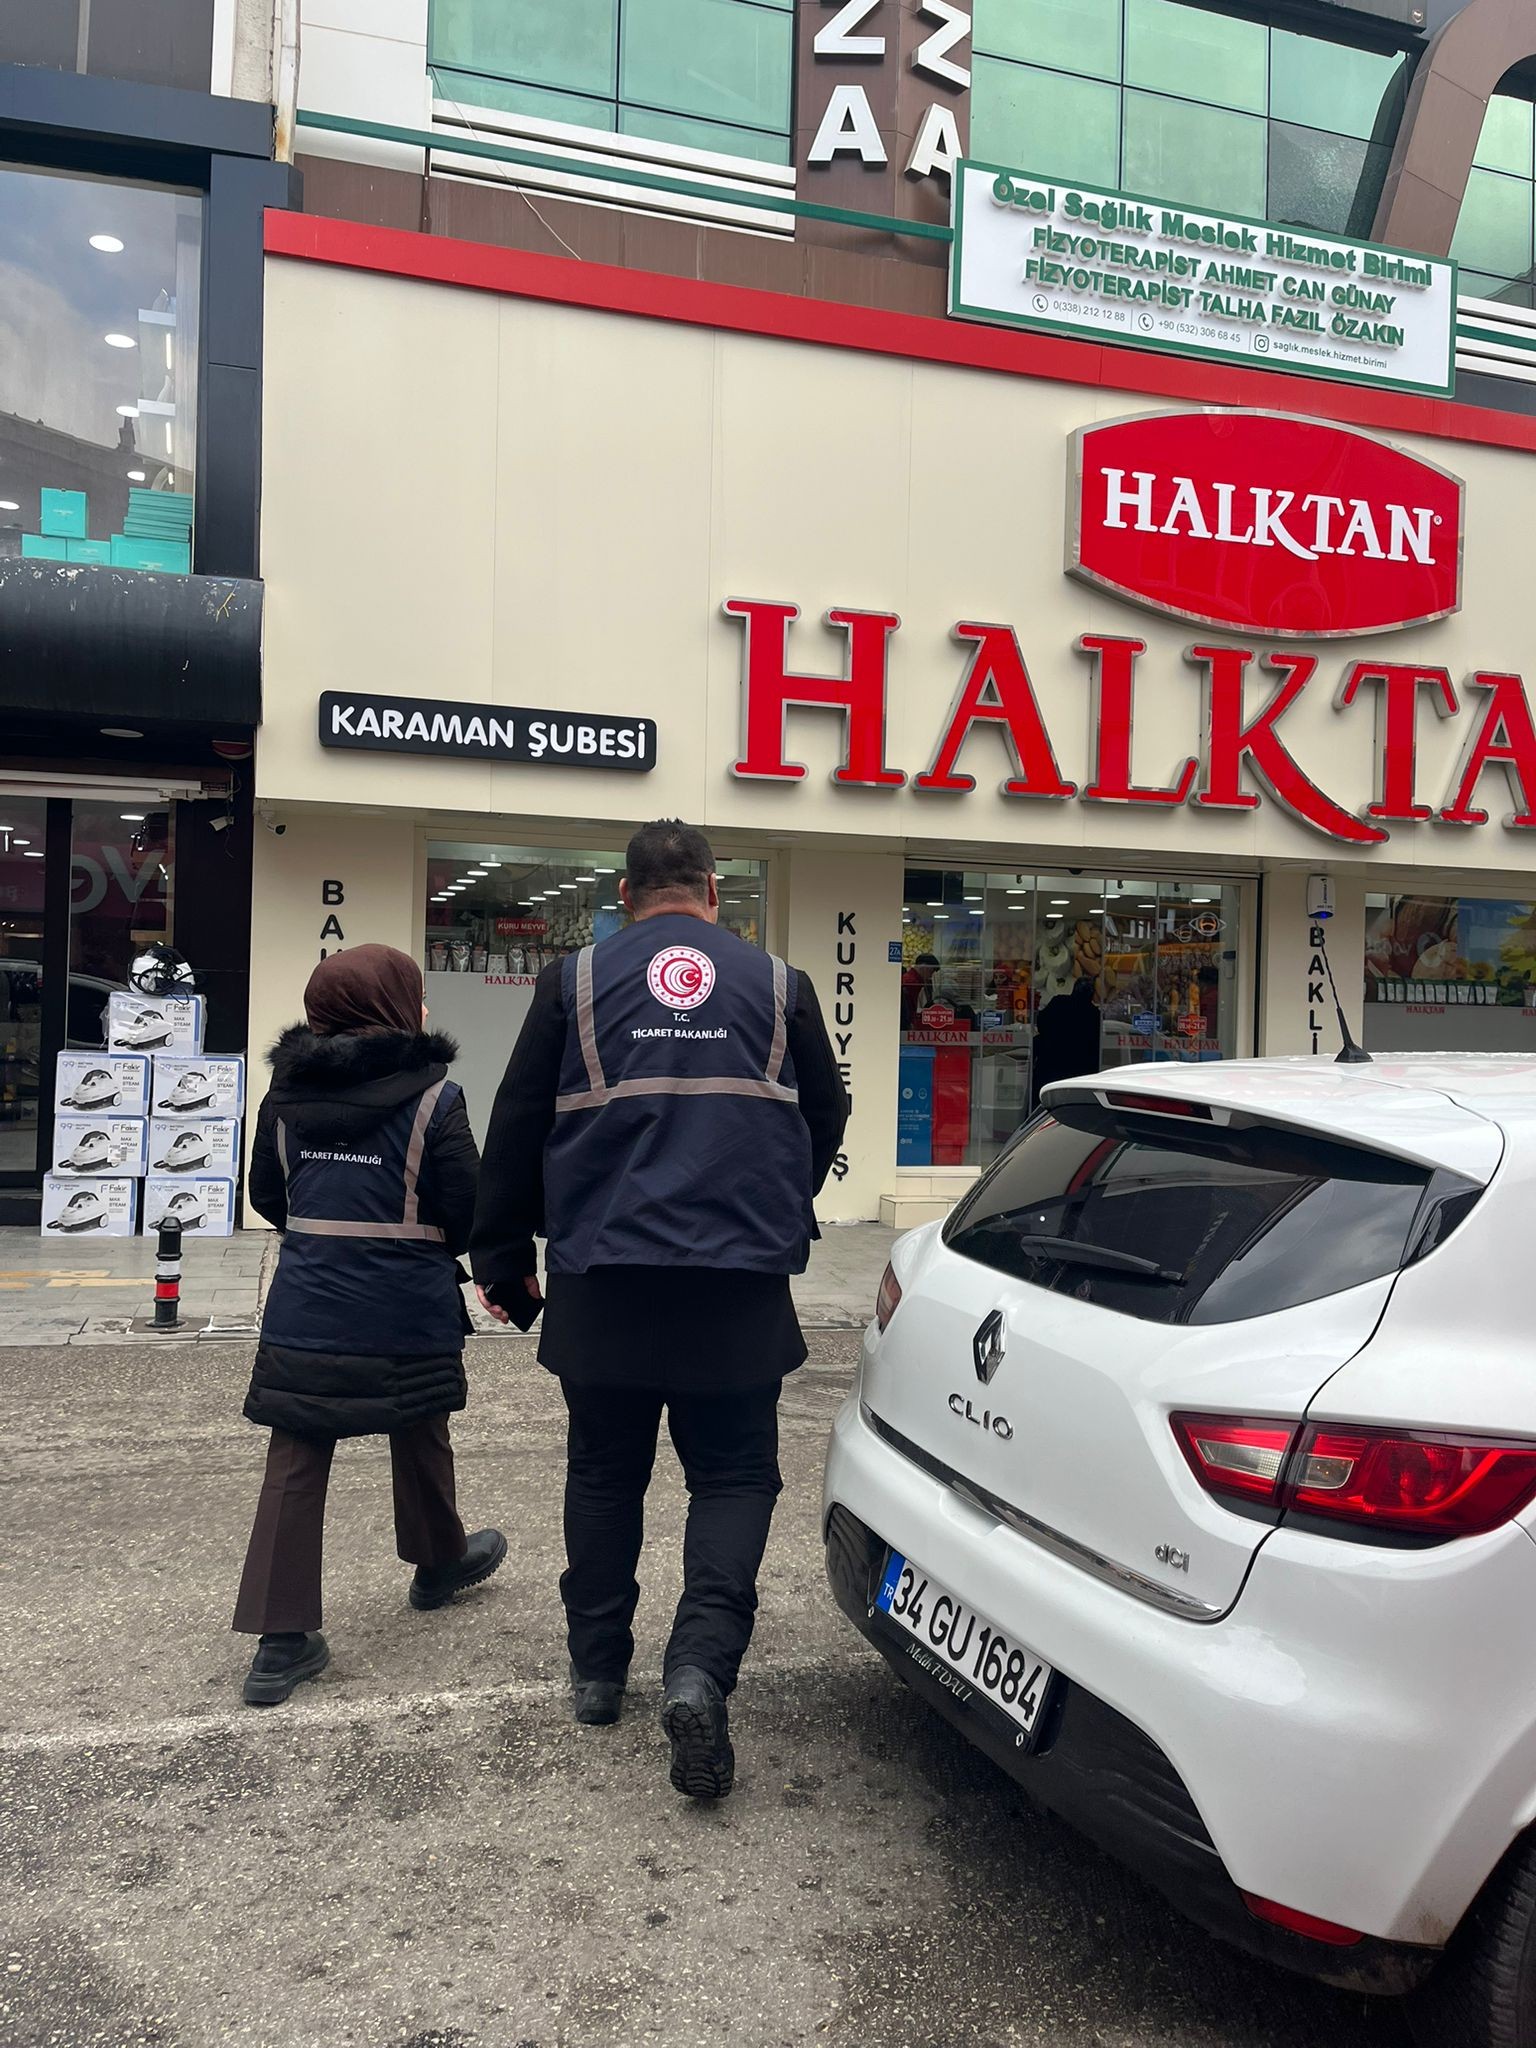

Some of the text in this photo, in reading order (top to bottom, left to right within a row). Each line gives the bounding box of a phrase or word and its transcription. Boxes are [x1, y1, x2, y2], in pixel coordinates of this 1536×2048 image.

[992, 172, 1432, 287] Özel Sağlık Meslek Hizmet Birimi
[1033, 225, 1397, 315] FİZYOTERAPİST AHMET CAN GÜNAY
[1025, 256, 1405, 346] FİZYOTERAPİST TALHA FAZIL ÖZAKIN
[1053, 300, 1126, 322] 0(338) 212 12 88
[1158, 320, 1241, 342] +90 (532) 306 68 45
[332, 704, 646, 758] KARAMAN ŞUBESİ
[498, 922, 546, 931] KURU MEYVE
[673, 1012, 691, 1022] T.C.
[631, 1028, 728, 1039] TİCARET BAKANLIĞI
[907, 1031, 968, 1043] HALKTAN
[300, 1149, 382, 1165] TİCARET BAKANLIĞI
[948, 1392, 1014, 1441] CLIO
[883, 1582, 894, 1601] TR
[892, 1567, 1043, 1722] 34 GU 1684
